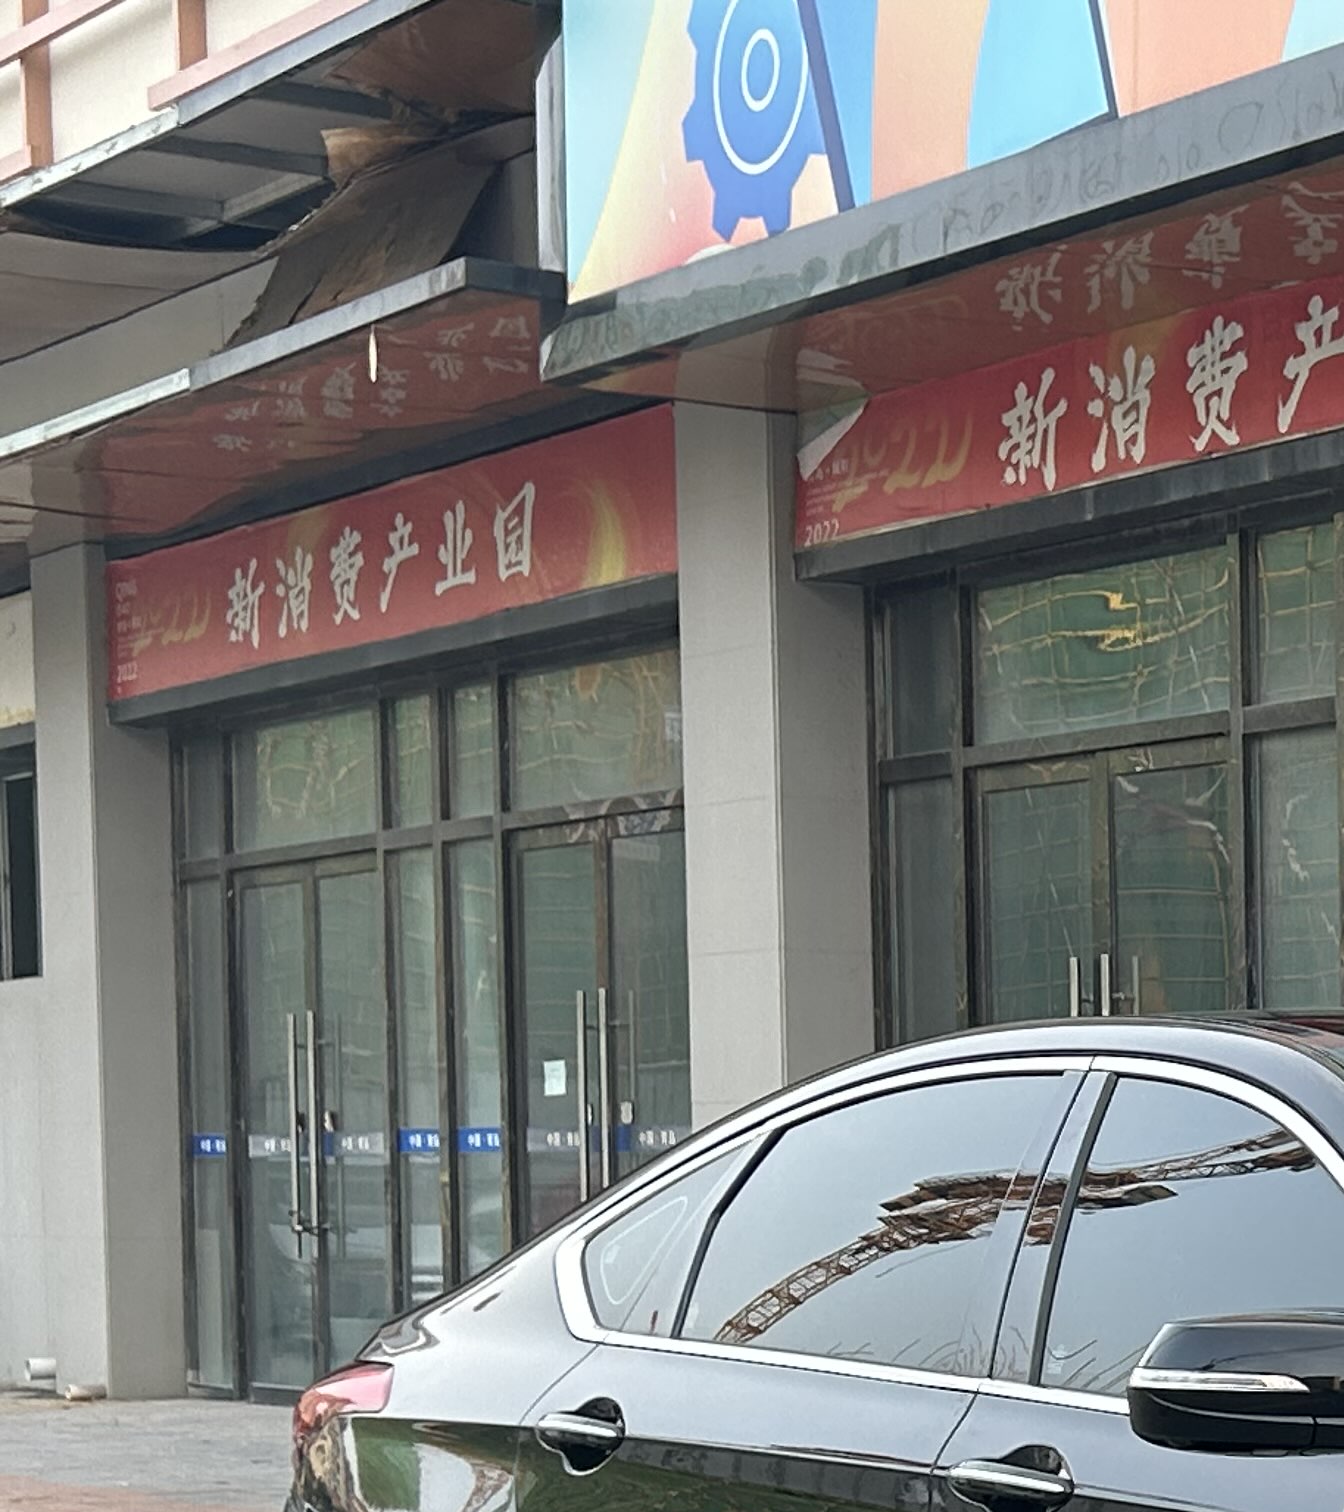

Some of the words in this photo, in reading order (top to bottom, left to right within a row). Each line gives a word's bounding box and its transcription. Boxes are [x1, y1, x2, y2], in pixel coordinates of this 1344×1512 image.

[226, 480, 535, 649] 新消费产业园
